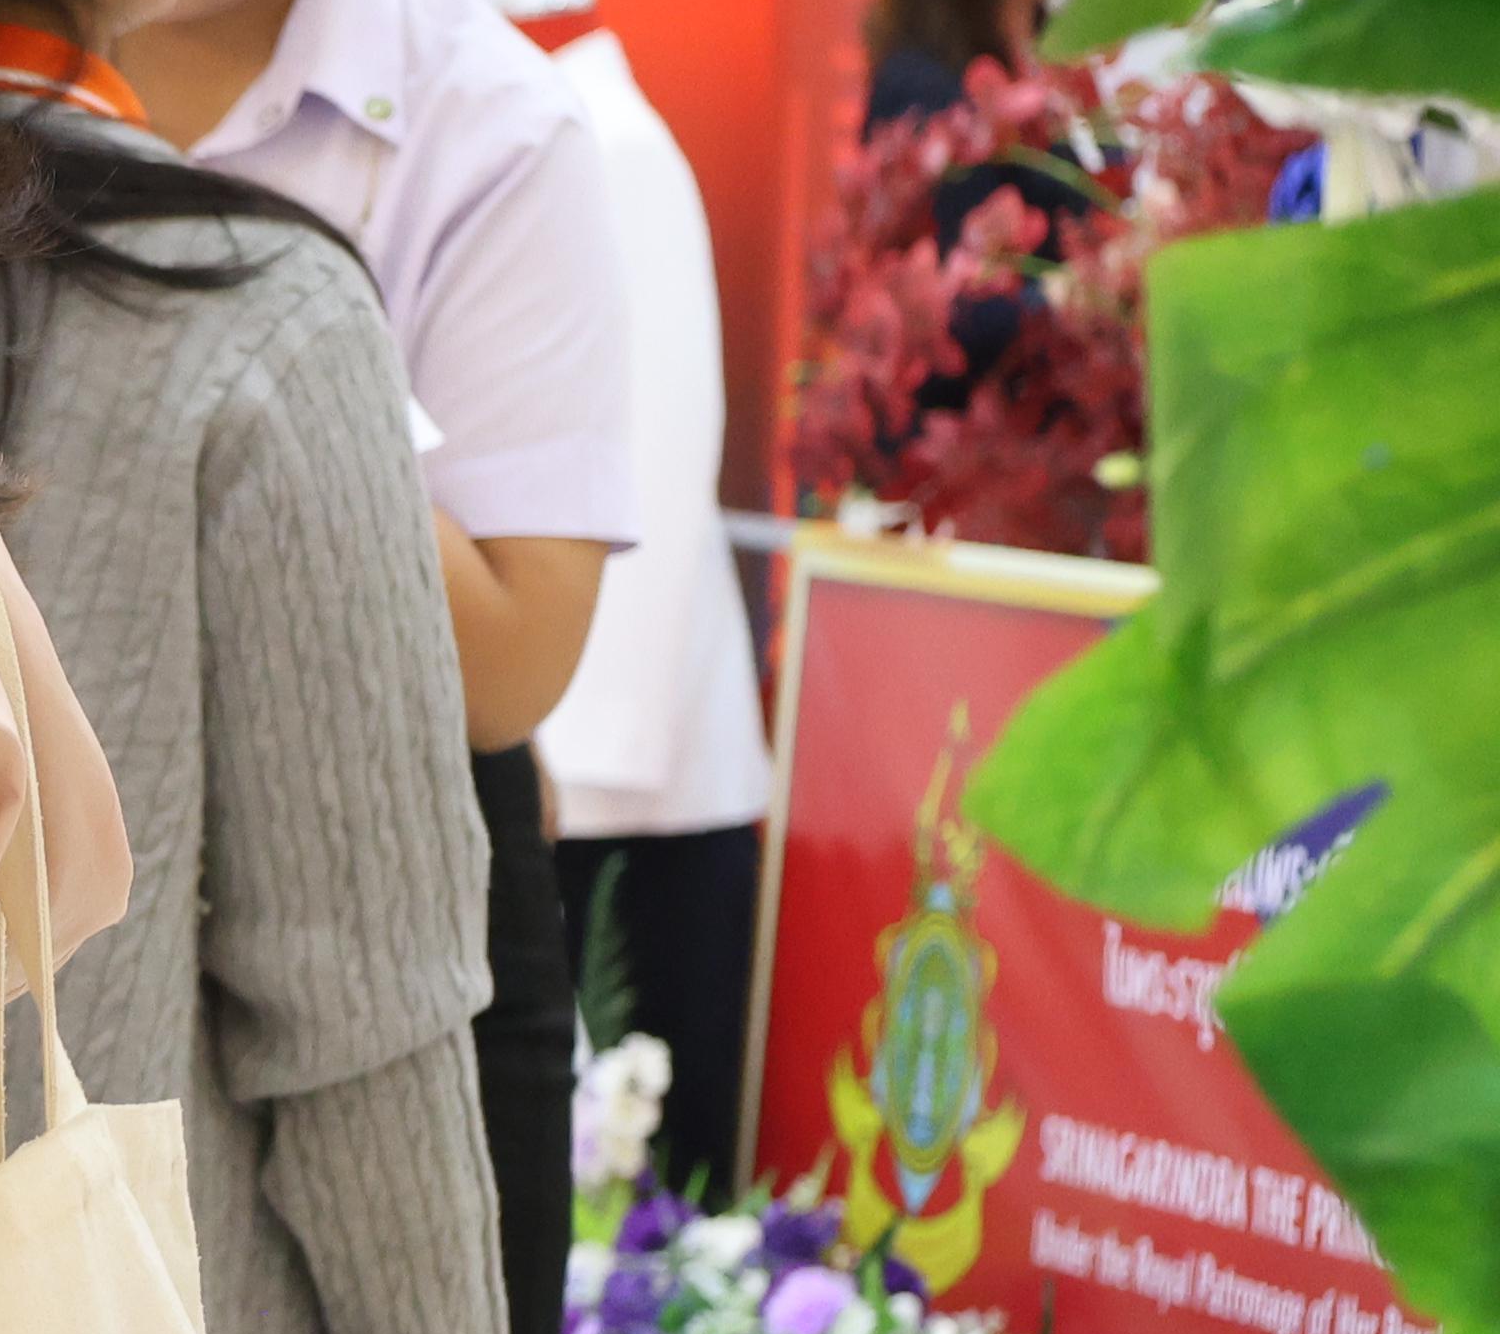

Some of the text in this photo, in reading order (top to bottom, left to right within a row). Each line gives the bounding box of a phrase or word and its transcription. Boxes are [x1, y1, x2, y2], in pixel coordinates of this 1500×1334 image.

[1251, 1166, 1305, 1248] THE
[1030, 1207, 1097, 1278] Under
[1095, 1229, 1132, 1289] the
[1133, 1234, 1198, 1315] Royal
